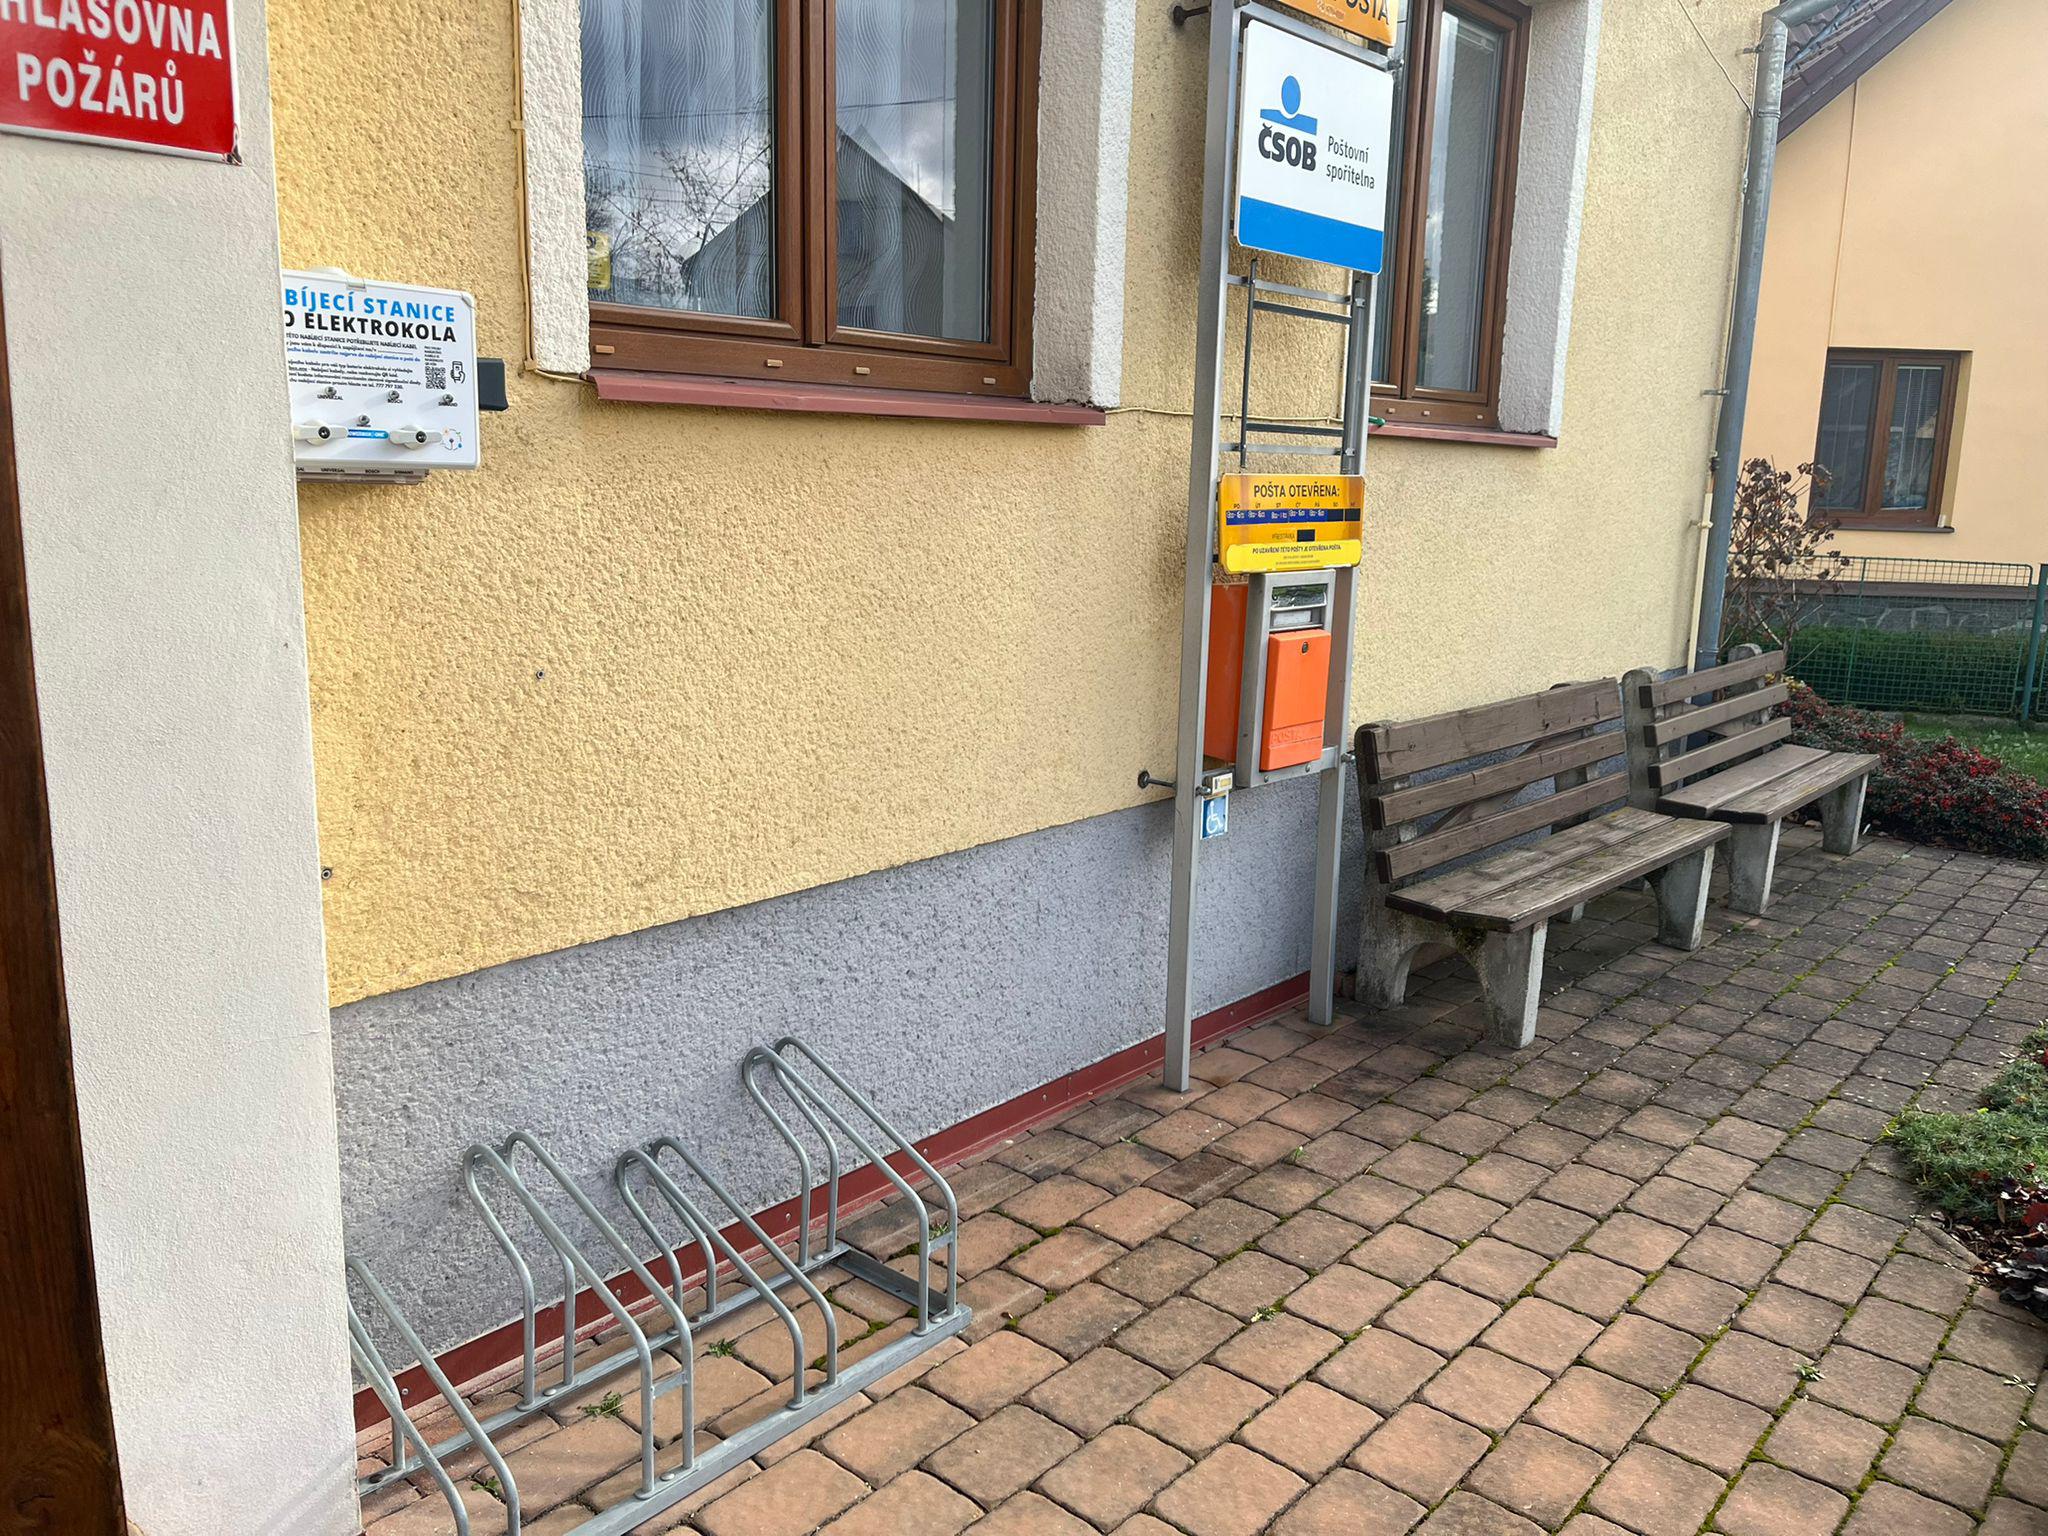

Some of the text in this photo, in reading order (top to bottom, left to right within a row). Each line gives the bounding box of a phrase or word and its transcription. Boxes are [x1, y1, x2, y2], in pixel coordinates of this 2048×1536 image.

[16, 48, 184, 125] POŽÁRŮ
[1258, 122, 1317, 171] ČSOB
[1328, 135, 1369, 164] Poštovní
[1326, 163, 1375, 189] spořitelna
[285, 286, 455, 322] BÍJECÍ STANICE
[305, 312, 457, 343] ELEKTROKOLA
[1254, 481, 1340, 498] POŠTA OTEVŘENA:
